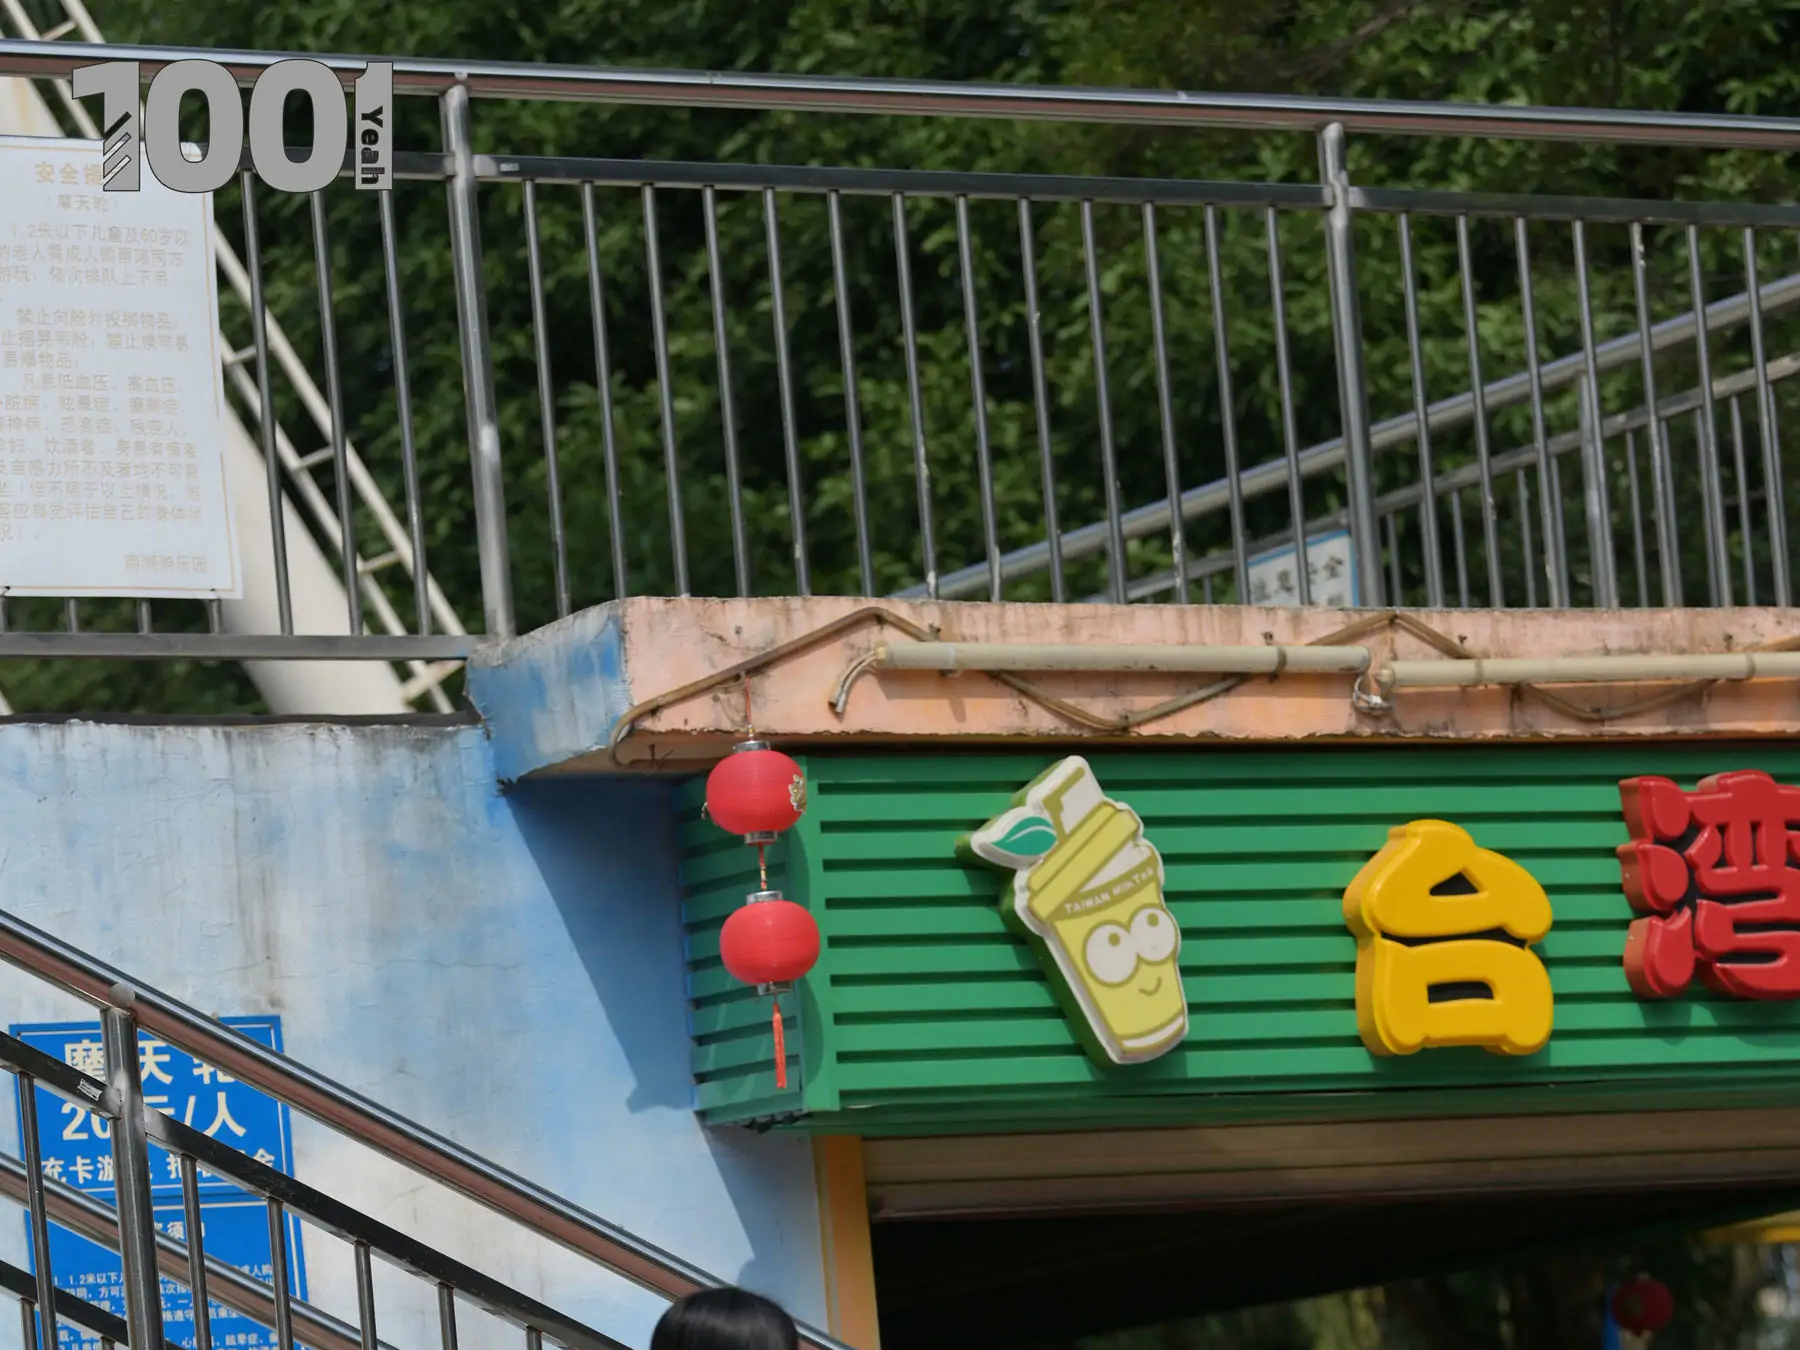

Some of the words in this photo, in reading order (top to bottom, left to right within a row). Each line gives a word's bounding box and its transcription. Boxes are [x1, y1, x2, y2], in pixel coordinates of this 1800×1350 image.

[34, 162, 104, 186] 安全提
[1064, 893, 1111, 914] TAIWAN
